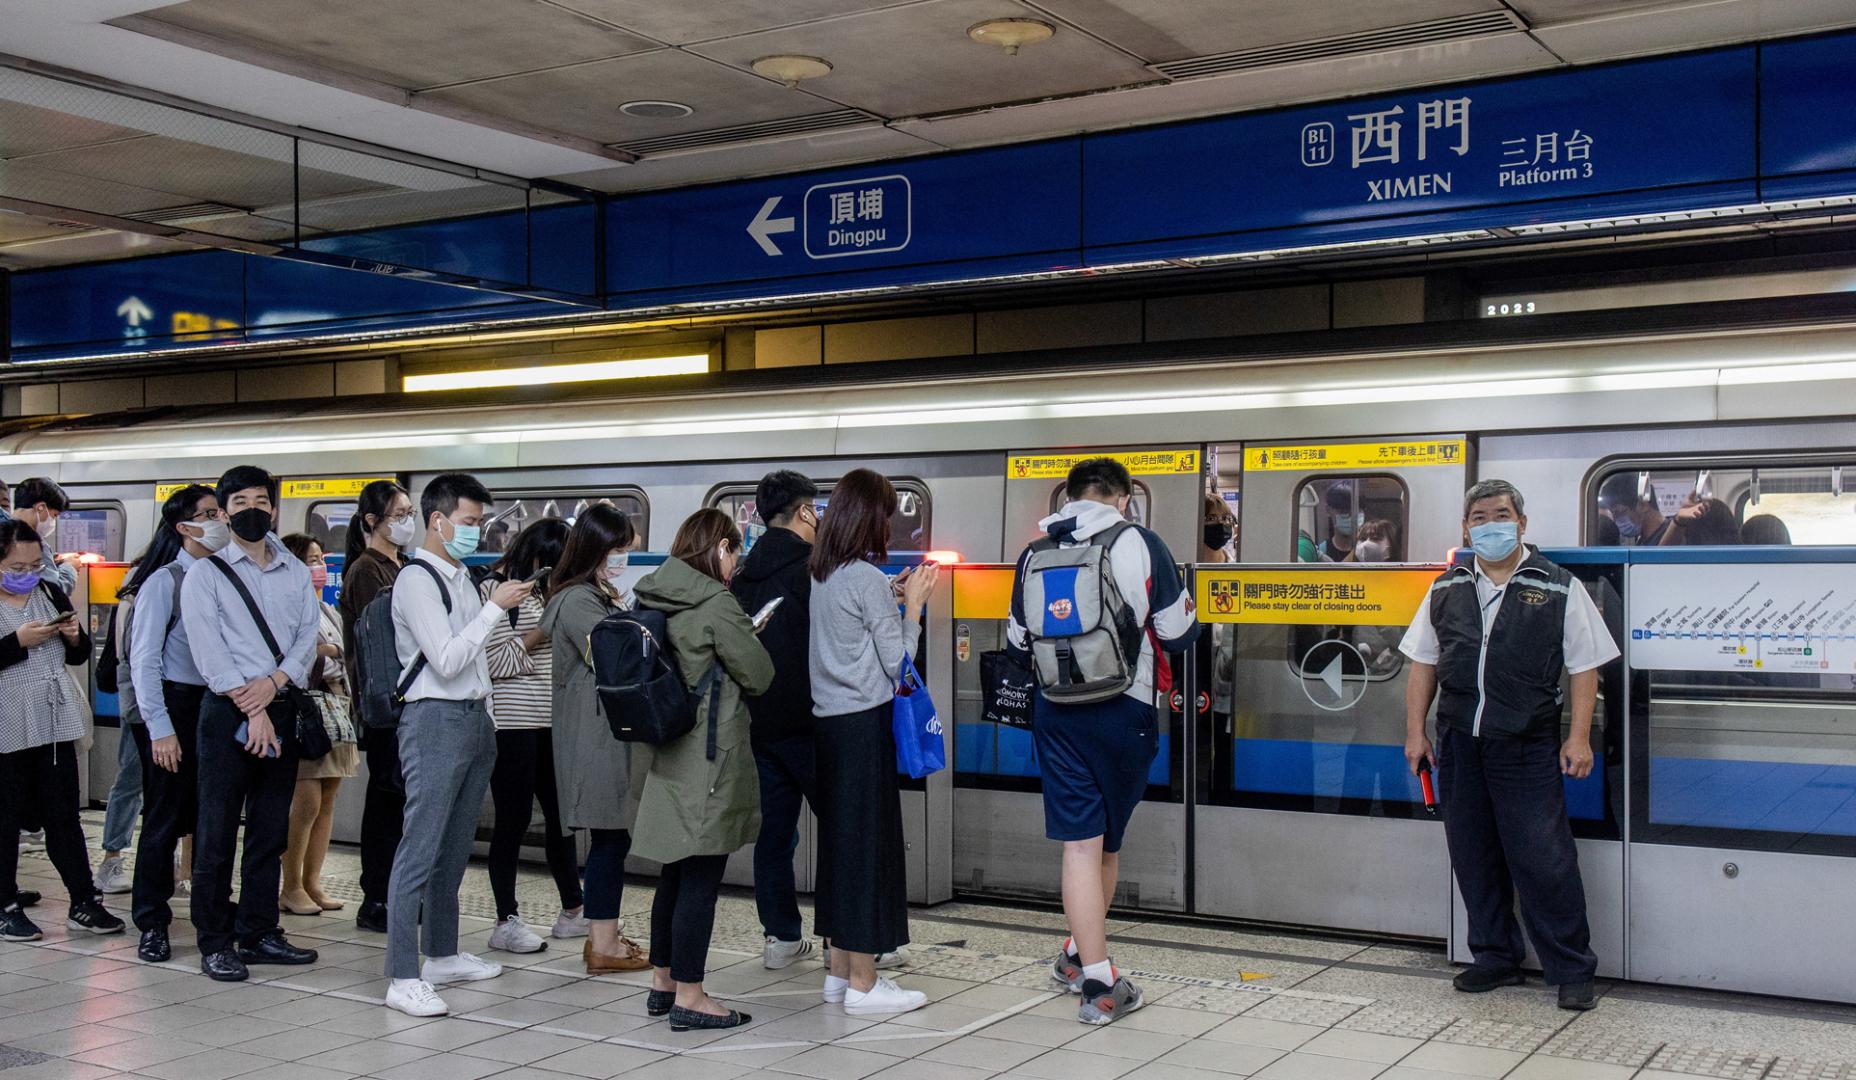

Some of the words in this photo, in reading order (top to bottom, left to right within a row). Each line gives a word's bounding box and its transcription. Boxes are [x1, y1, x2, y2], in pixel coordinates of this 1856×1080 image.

[1308, 129, 1328, 144] BL
[1347, 96, 1472, 169] 西門
[1308, 146, 1326, 161] 11
[1499, 129, 1594, 168] 三月台
[1499, 168, 1578, 188] Platform
[1582, 162, 1594, 178] 3
[1367, 172, 1451, 201] XIMEN
[829, 188, 884, 224] 頂埔
[828, 227, 886, 248] Dingpu
[1243, 583, 1366, 600] 關門時勿強行進出
[1244, 601, 1271, 610] Please
[1272, 601, 1289, 612] stay
[1291, 602, 1310, 610] clear
[1313, 602, 1322, 610] of
[1323, 602, 1354, 613] closing
[1356, 602, 1382, 611] doors
[1130, 970, 1212, 986] Waiting
[1223, 982, 1272, 992] Line
